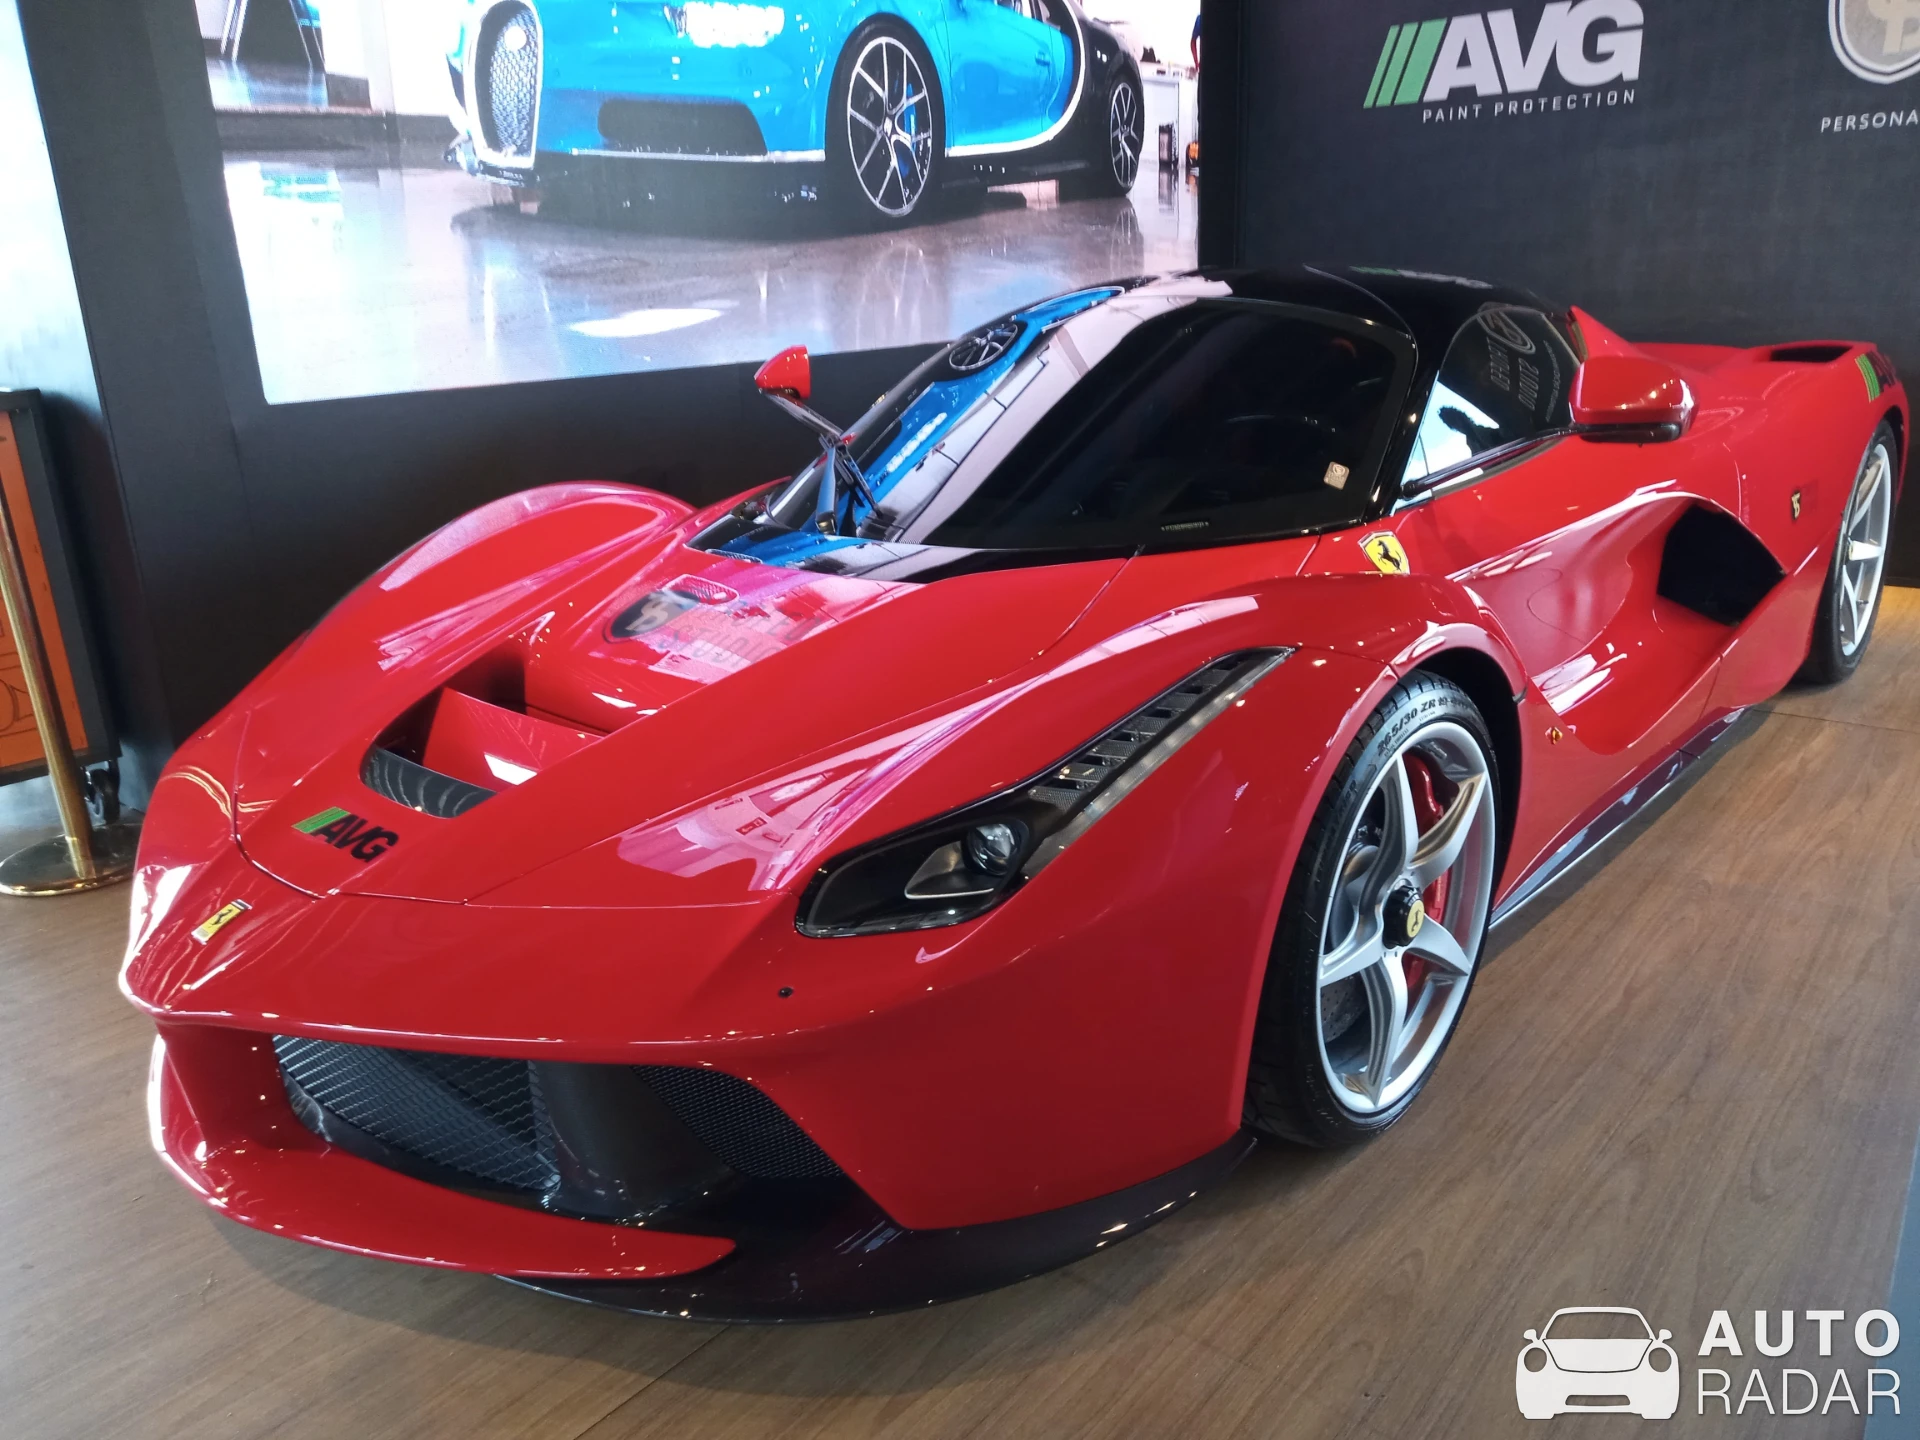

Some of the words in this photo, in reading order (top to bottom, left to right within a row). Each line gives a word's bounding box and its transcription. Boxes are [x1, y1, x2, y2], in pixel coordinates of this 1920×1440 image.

[1423, 0, 1644, 102] AVG
[1422, 103, 1482, 124] PAINT
[1494, 88, 1636, 117] PROTECTION
[1820, 108, 1919, 133] PERSONA
[1377, 707, 1418, 756] 265/30
[1420, 698, 1436, 713] ZR
[309, 813, 399, 863] AVG
